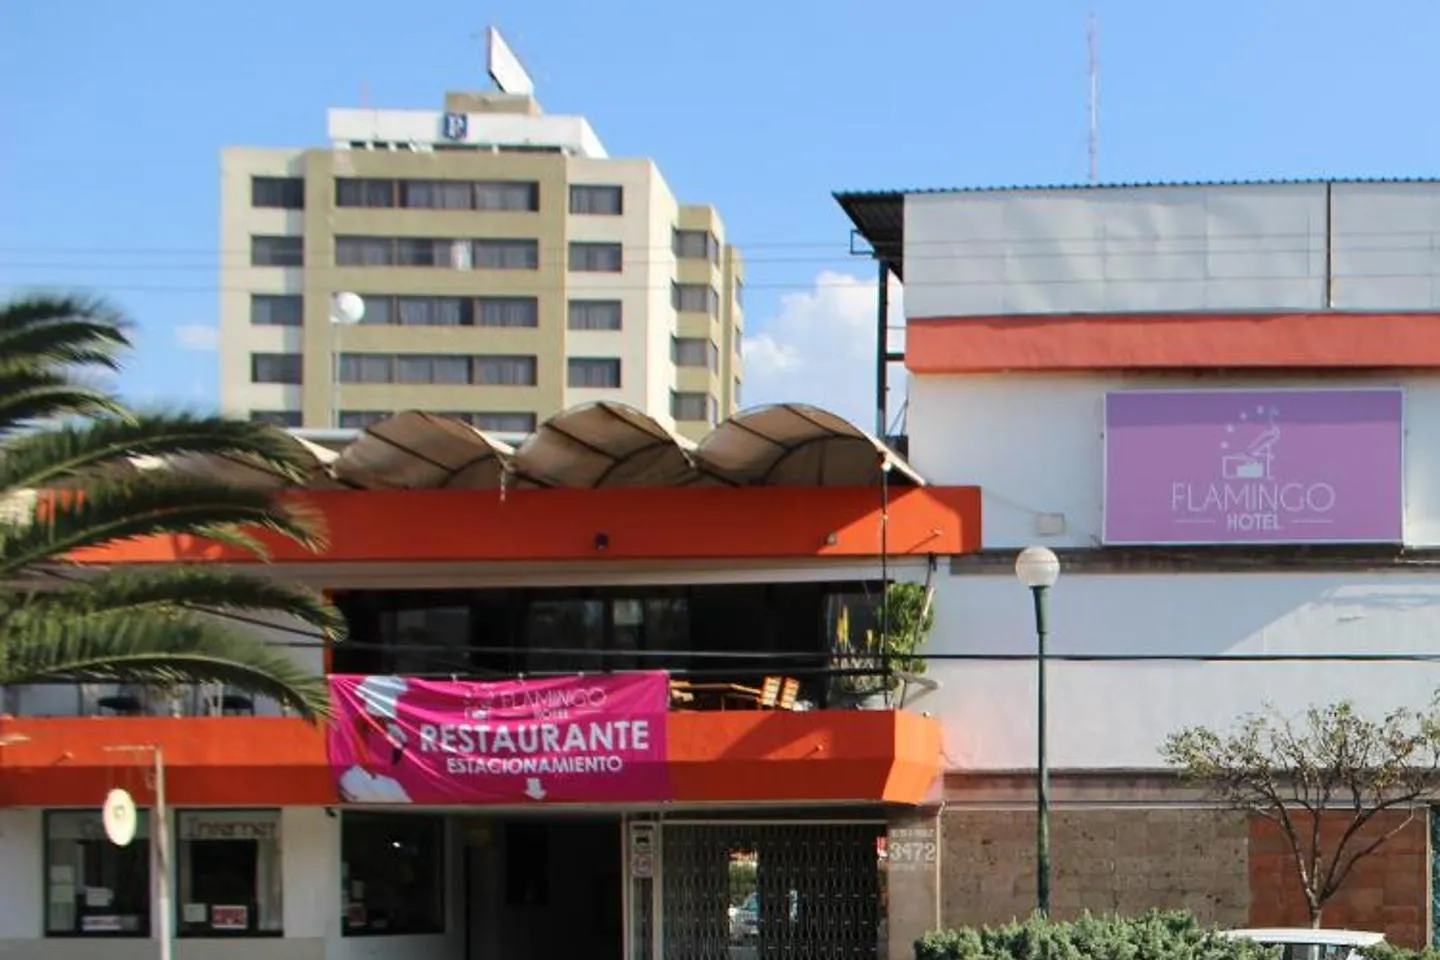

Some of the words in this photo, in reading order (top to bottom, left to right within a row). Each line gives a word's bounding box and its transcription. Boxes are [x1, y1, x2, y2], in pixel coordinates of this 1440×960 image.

[1171, 482, 1336, 512] FLAMINGO
[1226, 513, 1281, 531] HOTEL
[501, 687, 607, 710] FLAMINGO
[419, 721, 650, 753] RESTAURANTE
[447, 755, 624, 775] ESTACIONAMIENTO
